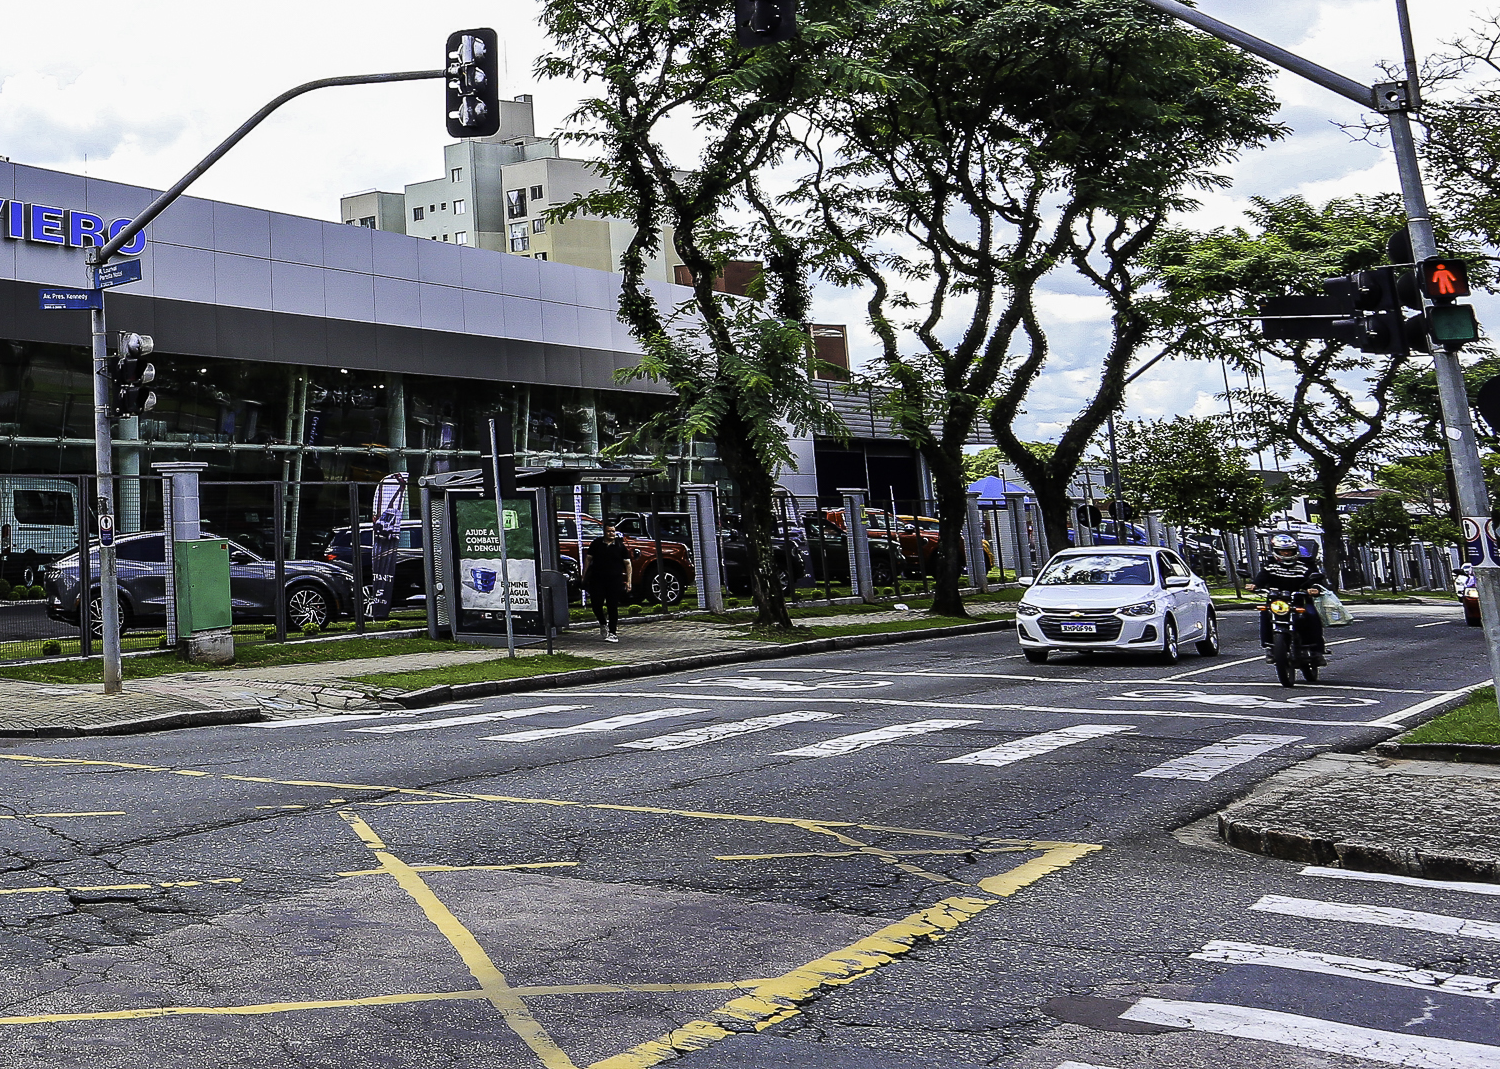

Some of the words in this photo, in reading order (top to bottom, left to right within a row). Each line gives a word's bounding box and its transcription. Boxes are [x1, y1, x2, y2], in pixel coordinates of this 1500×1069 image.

[66, 293, 88, 301] Kennedy
[465, 528, 488, 536] AJUDE
[489, 528, 495, 536] A
[466, 536, 500, 544] COMBATE
[500, 581, 529, 589] EIMINE
[500, 597, 531, 605] PRADA
